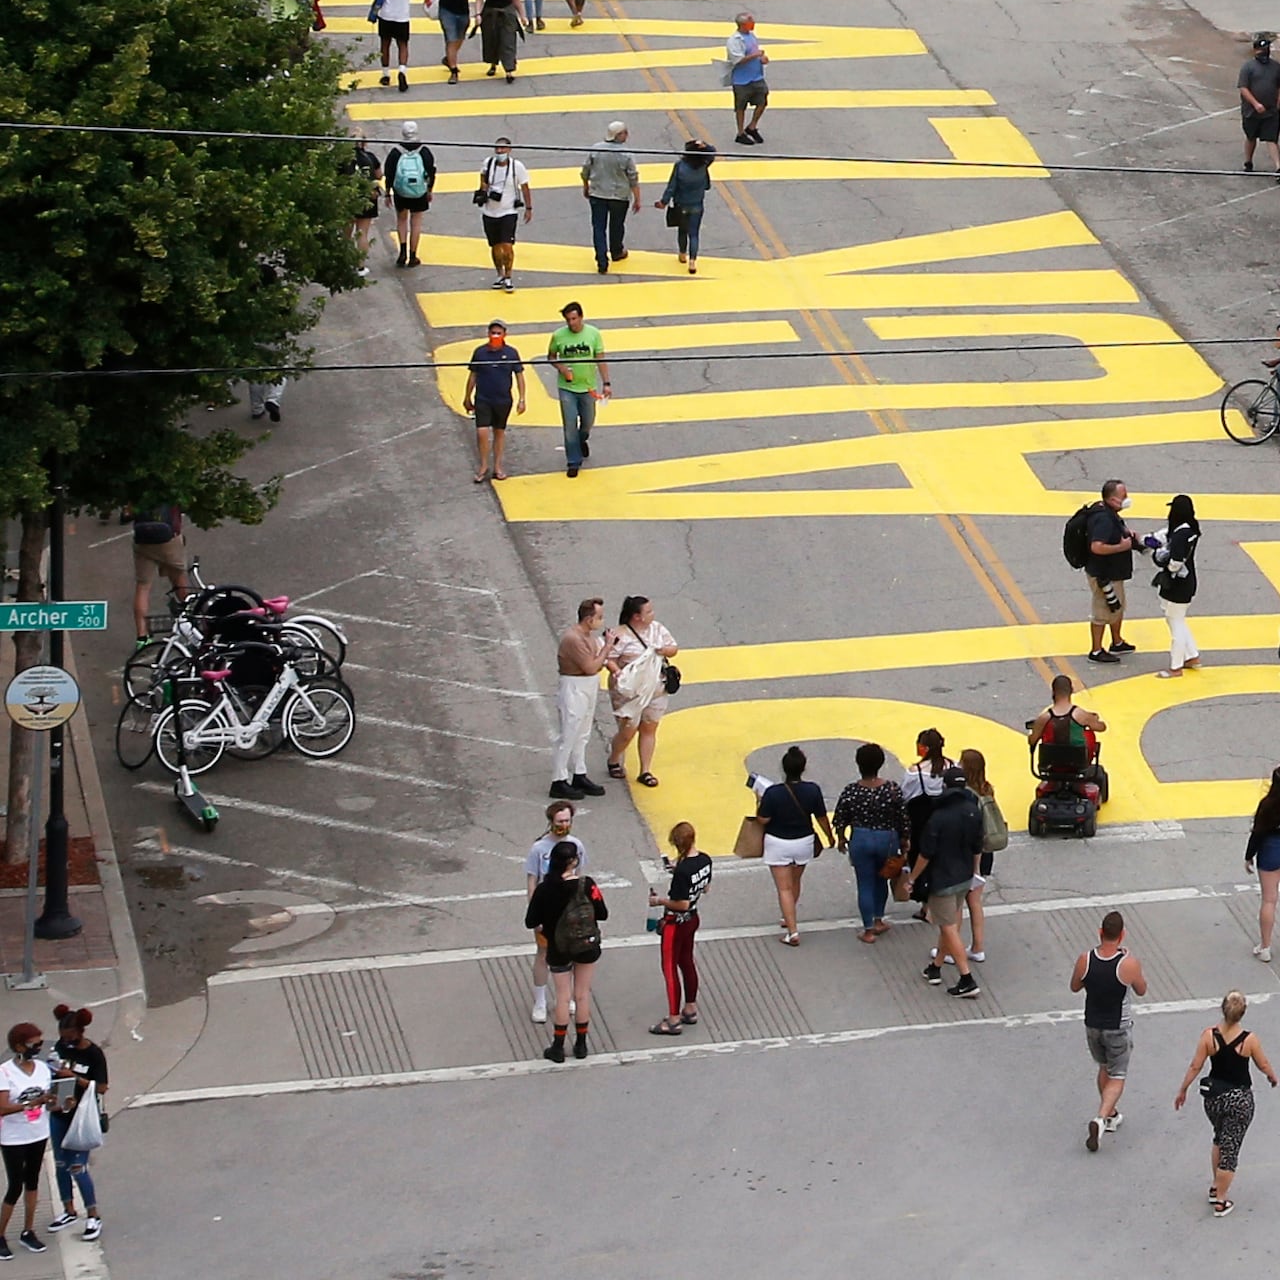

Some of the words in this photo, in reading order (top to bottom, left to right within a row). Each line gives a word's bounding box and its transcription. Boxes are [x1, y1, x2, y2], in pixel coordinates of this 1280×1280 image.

[8, 608, 68, 625] Archer
[83, 605, 96, 615] ST
[78, 616, 100, 627] 500
